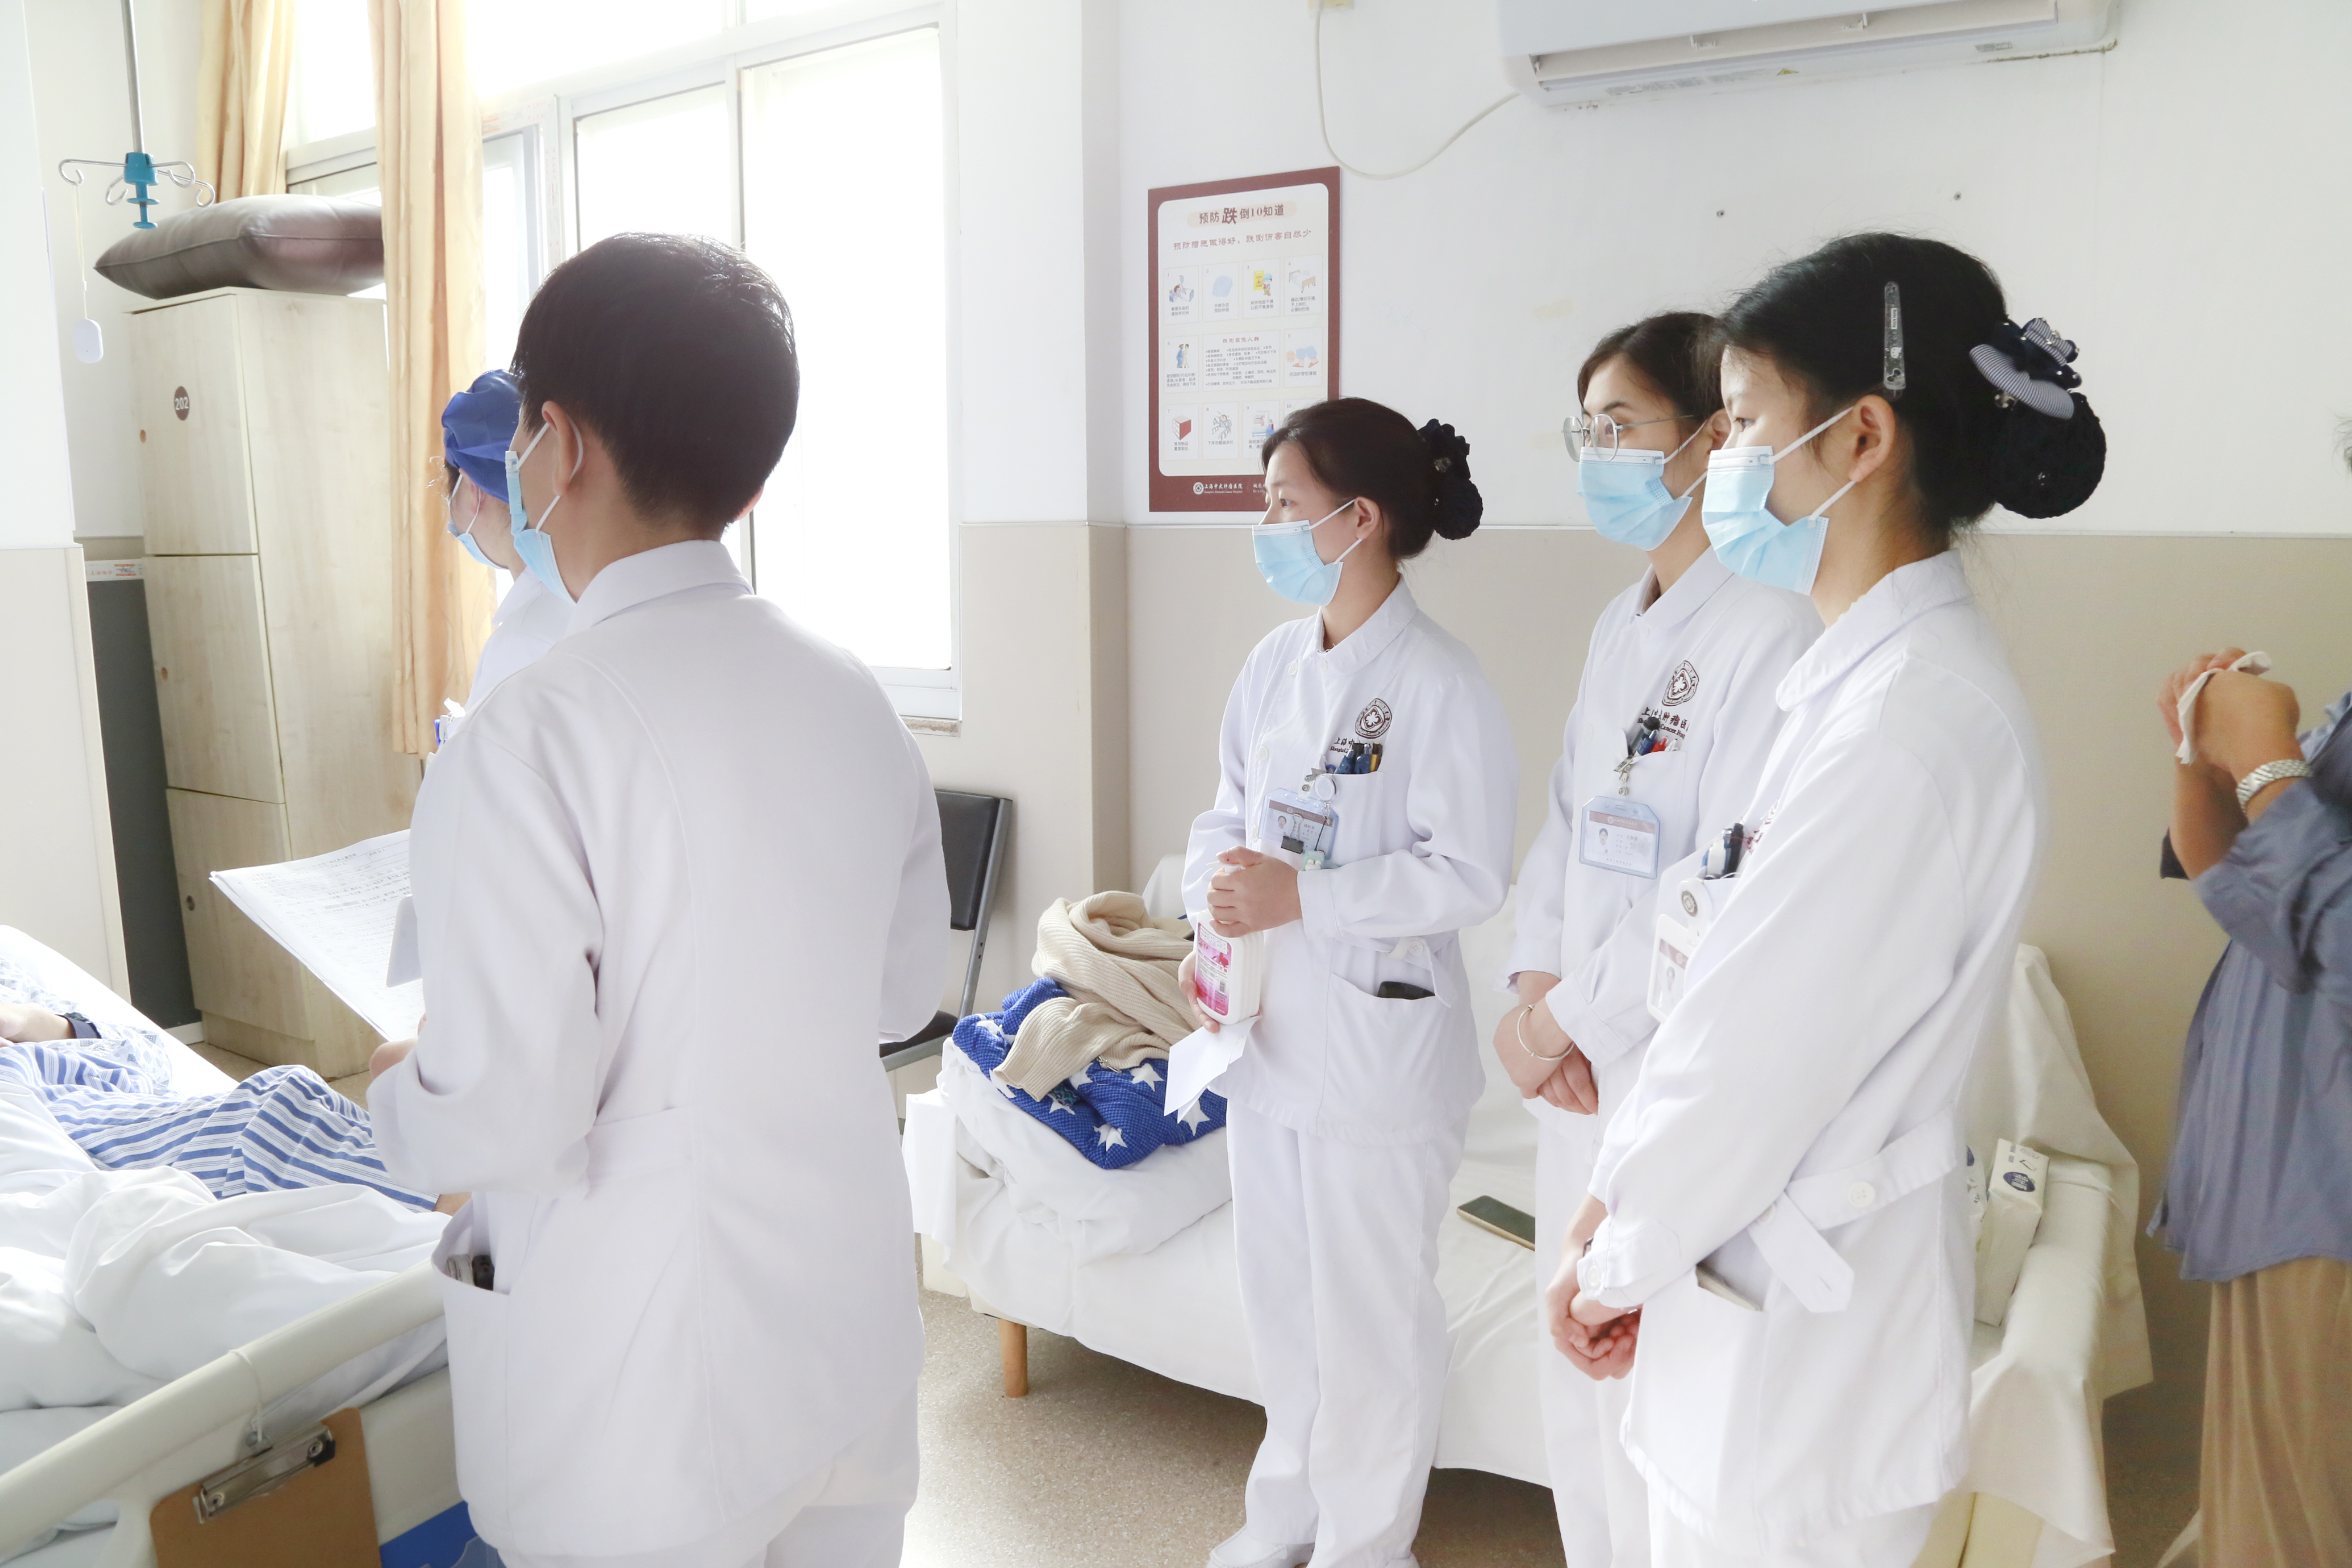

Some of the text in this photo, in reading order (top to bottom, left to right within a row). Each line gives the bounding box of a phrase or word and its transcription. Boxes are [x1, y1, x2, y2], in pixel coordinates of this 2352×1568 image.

[1199, 204, 1285, 225] 预防跌倒10知道
[175, 397, 189, 410] 202
